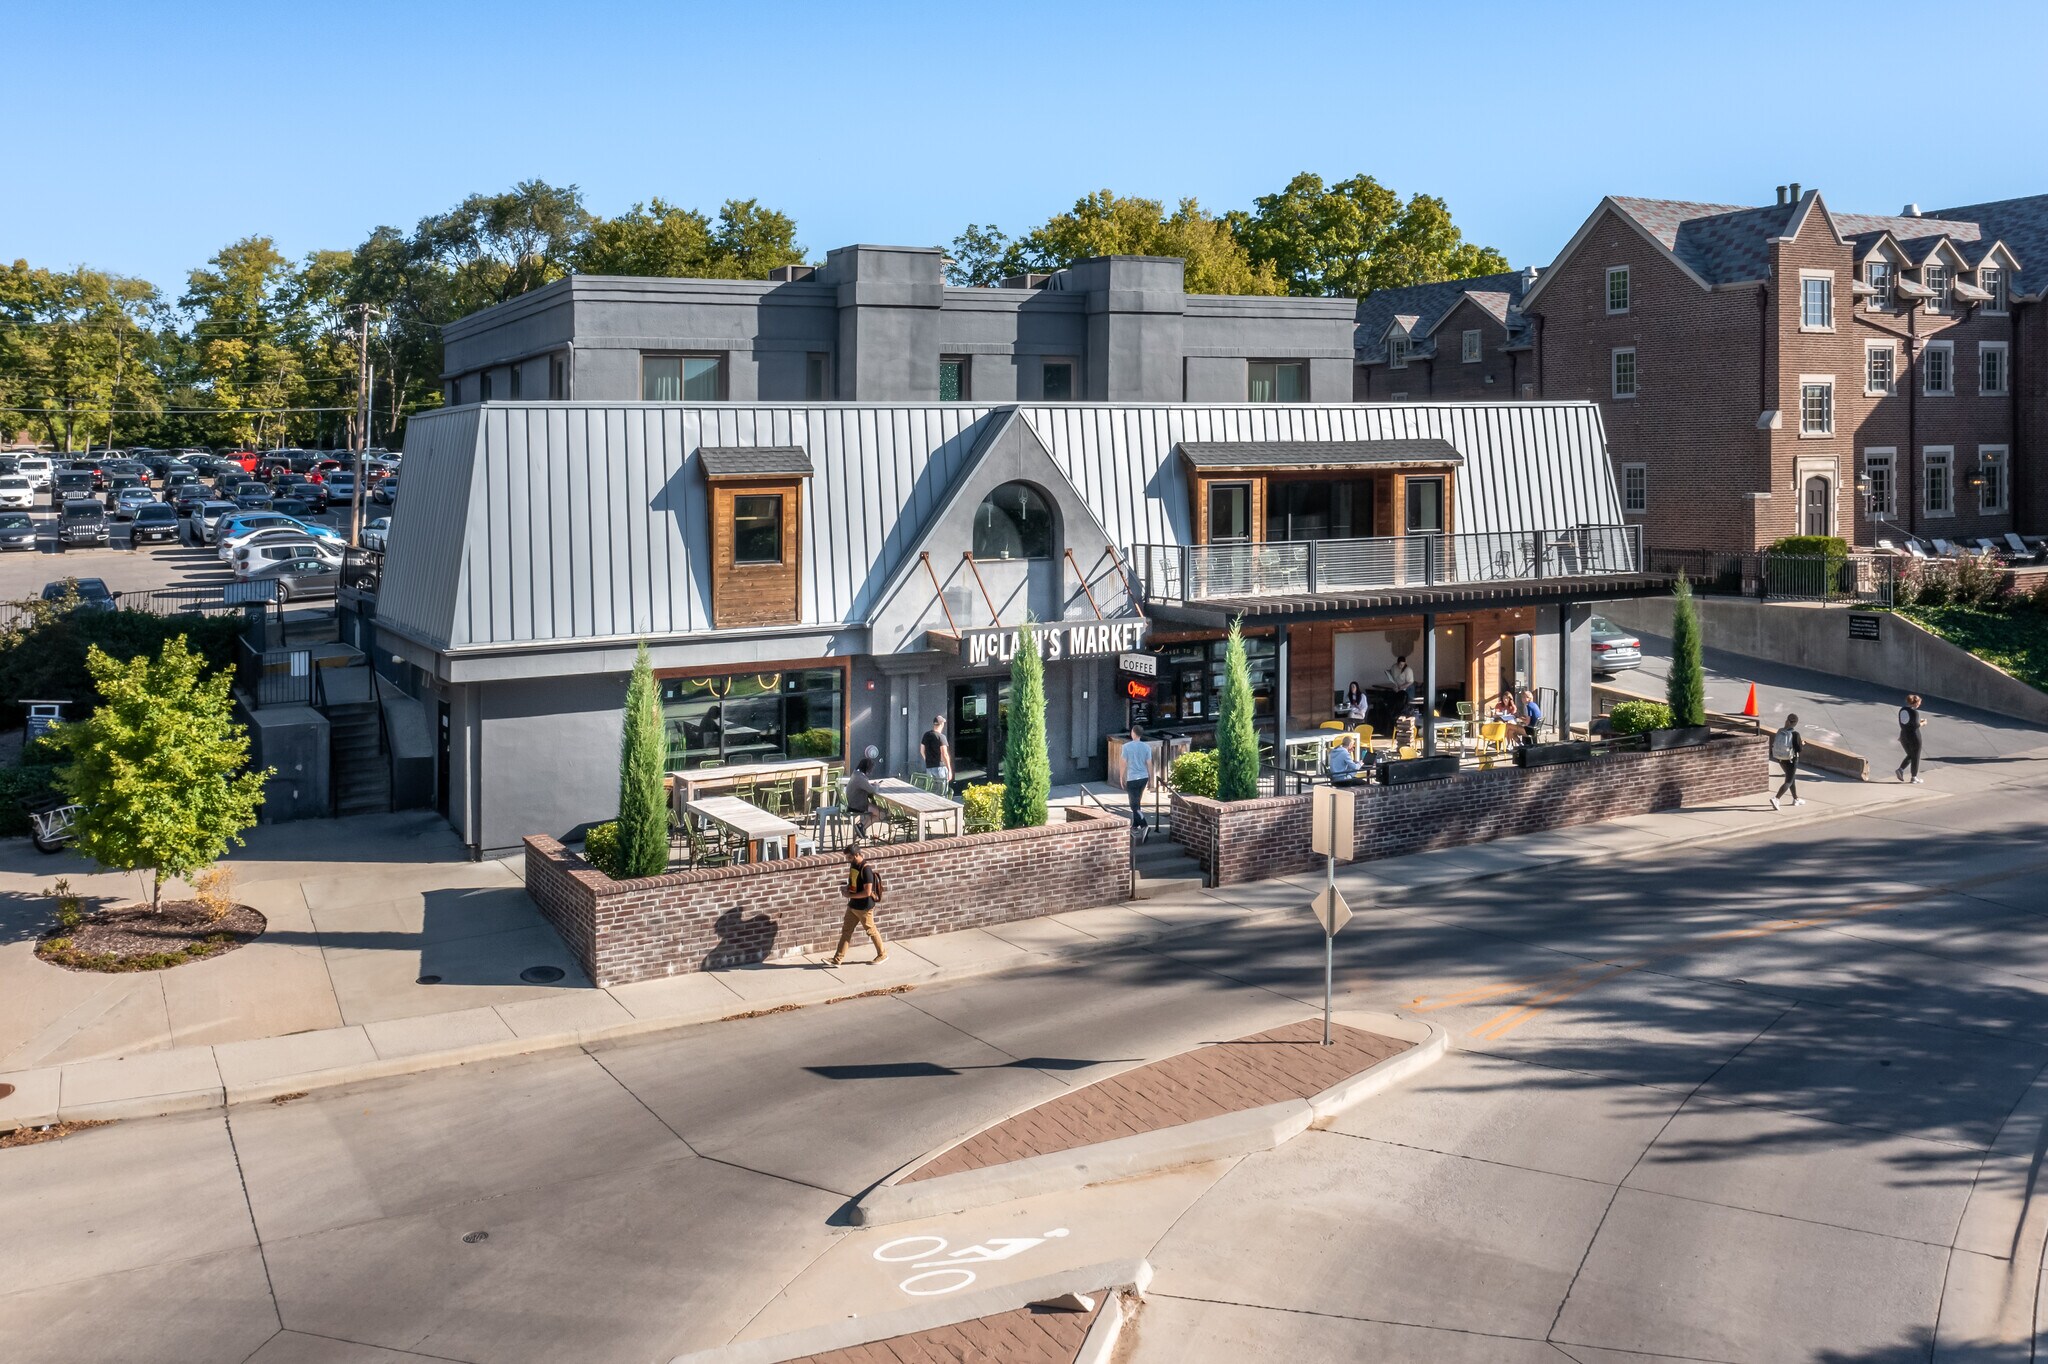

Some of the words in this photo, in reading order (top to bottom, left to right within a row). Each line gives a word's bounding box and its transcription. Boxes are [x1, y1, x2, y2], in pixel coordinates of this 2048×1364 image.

[970, 628, 1062, 663] McLAN'S
[1070, 622, 1144, 655] MARKET
[1123, 659, 1153, 674] COFFEE
